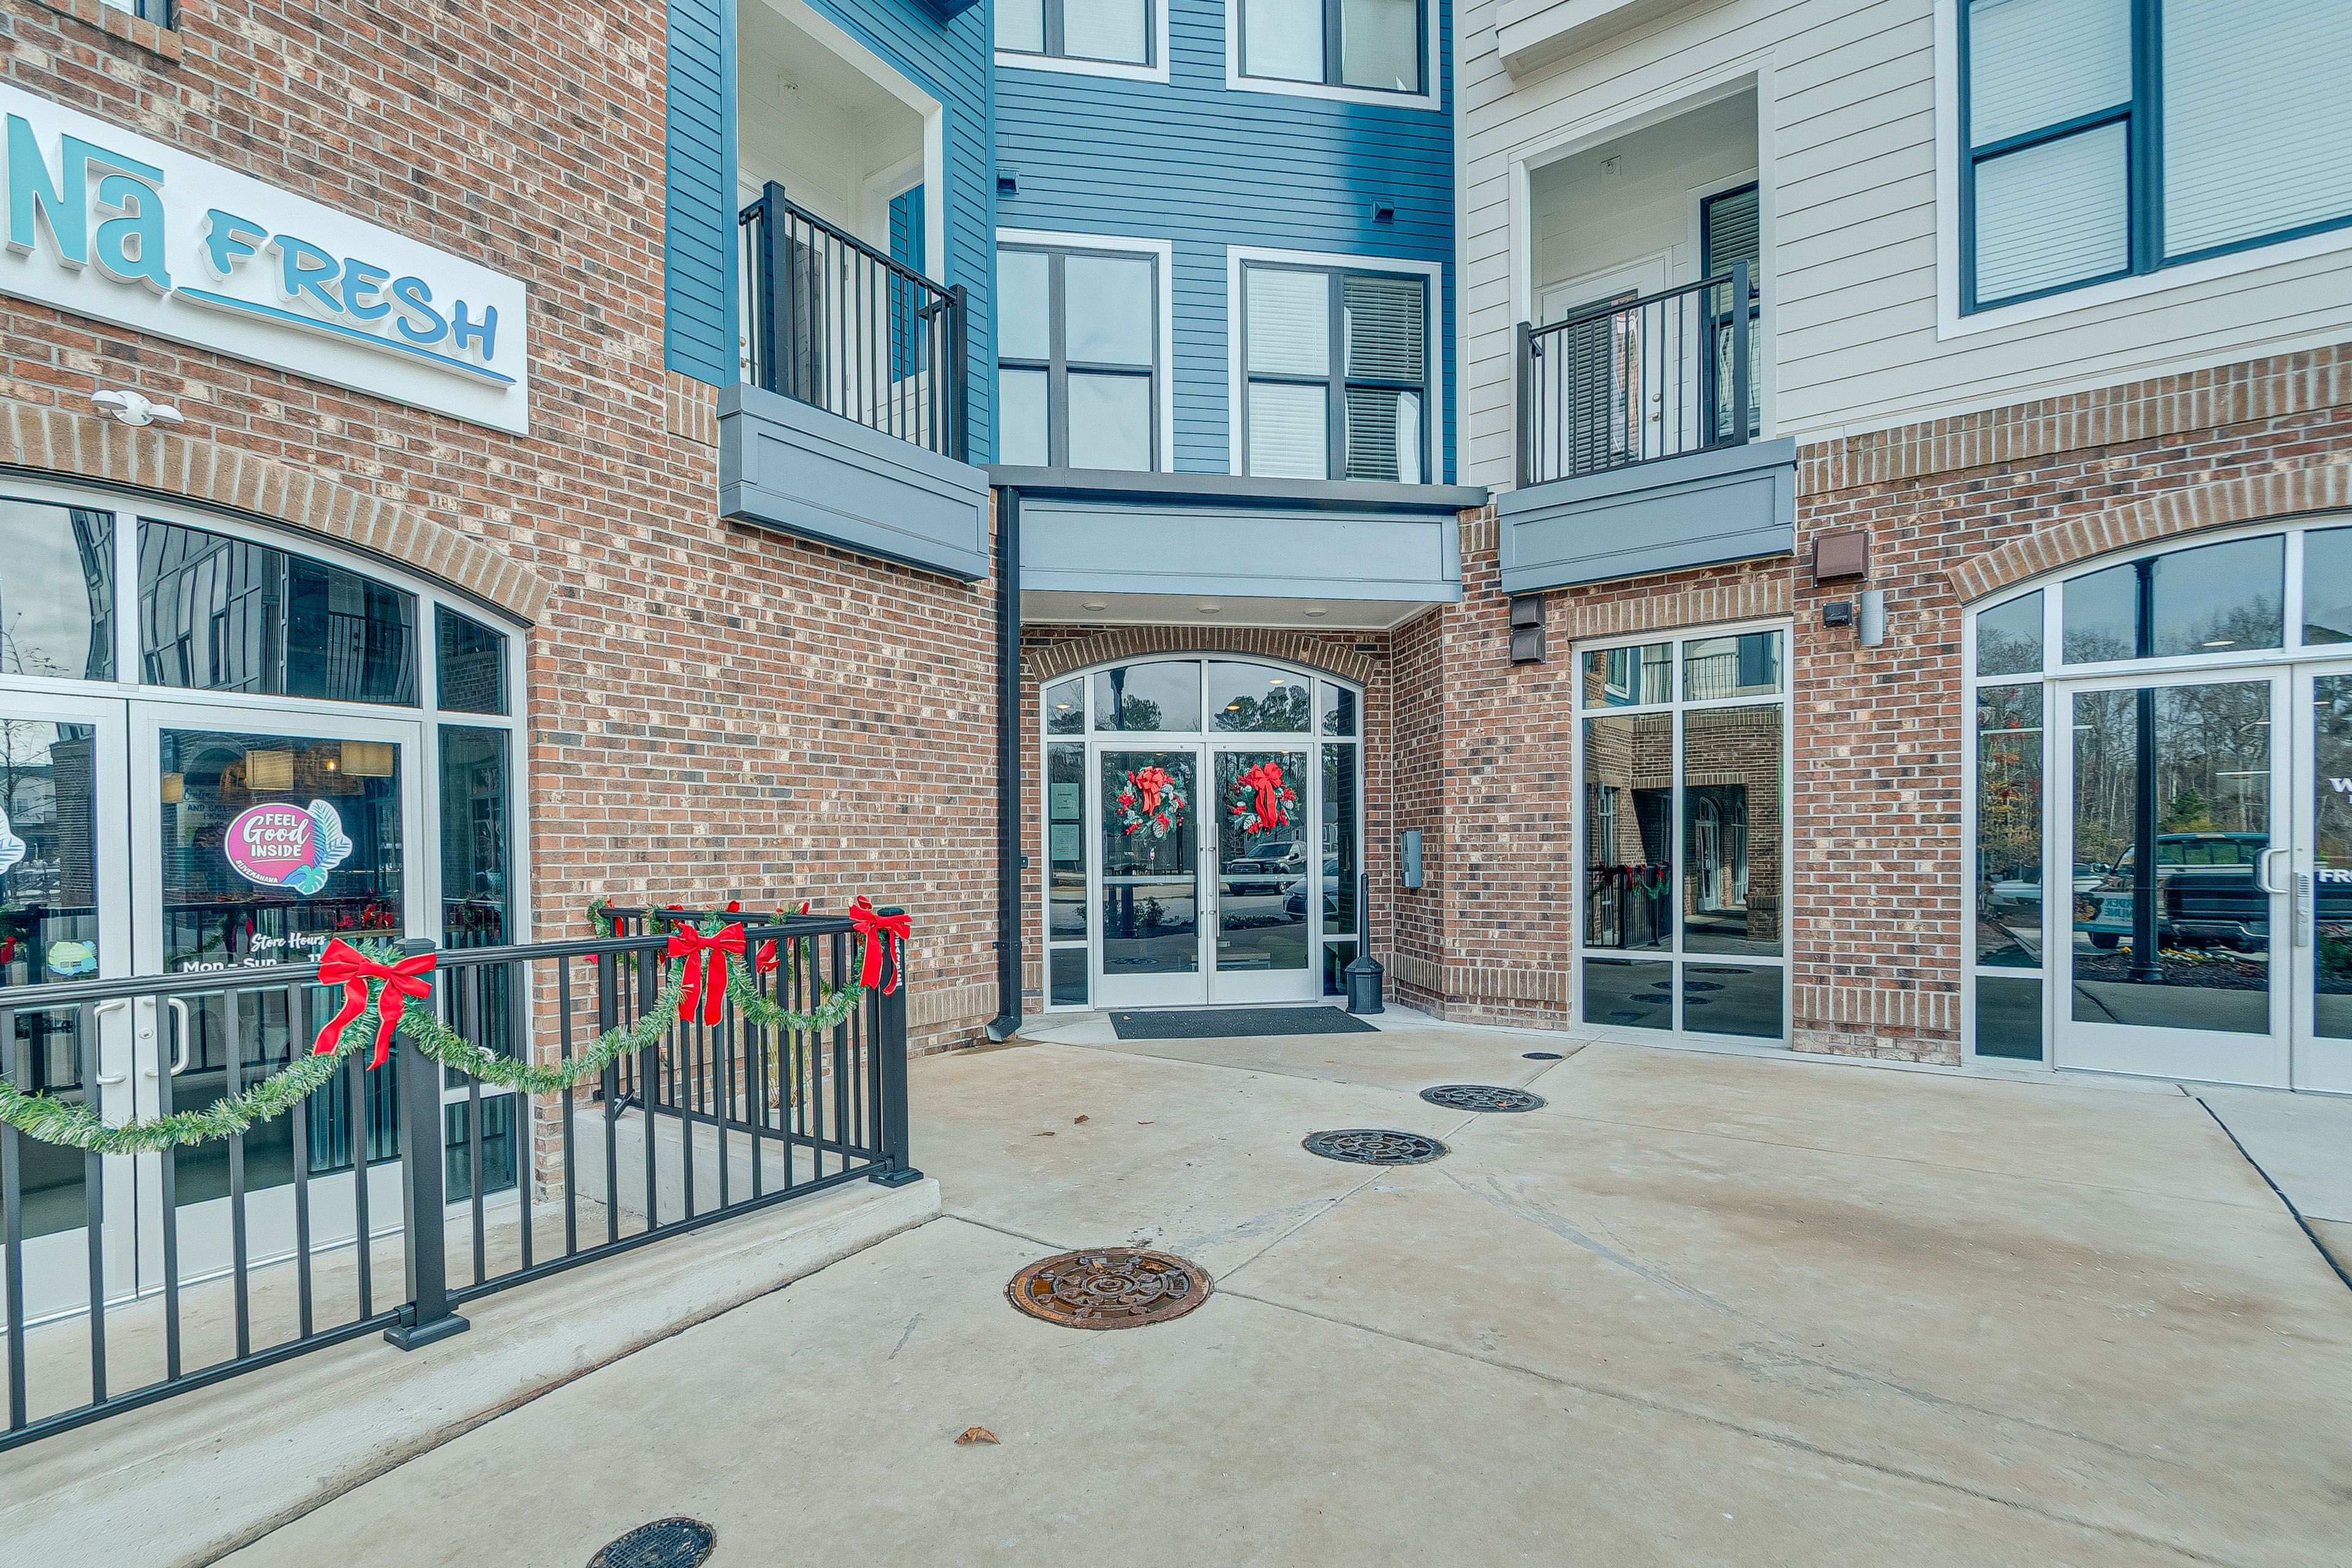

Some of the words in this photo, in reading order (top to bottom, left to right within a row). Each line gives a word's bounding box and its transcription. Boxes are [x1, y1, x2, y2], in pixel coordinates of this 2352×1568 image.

[206, 208, 498, 361] FRESH
[243, 815, 311, 844] Good
[266, 813, 298, 826] FEEL
[251, 845, 302, 857] INSIDE
[235, 859, 279, 883] #LIVEMAHANA
[251, 932, 287, 952] Store
[288, 932, 326, 949] Hours
[184, 960, 224, 973] Mon
[243, 957, 277, 968] Sun
